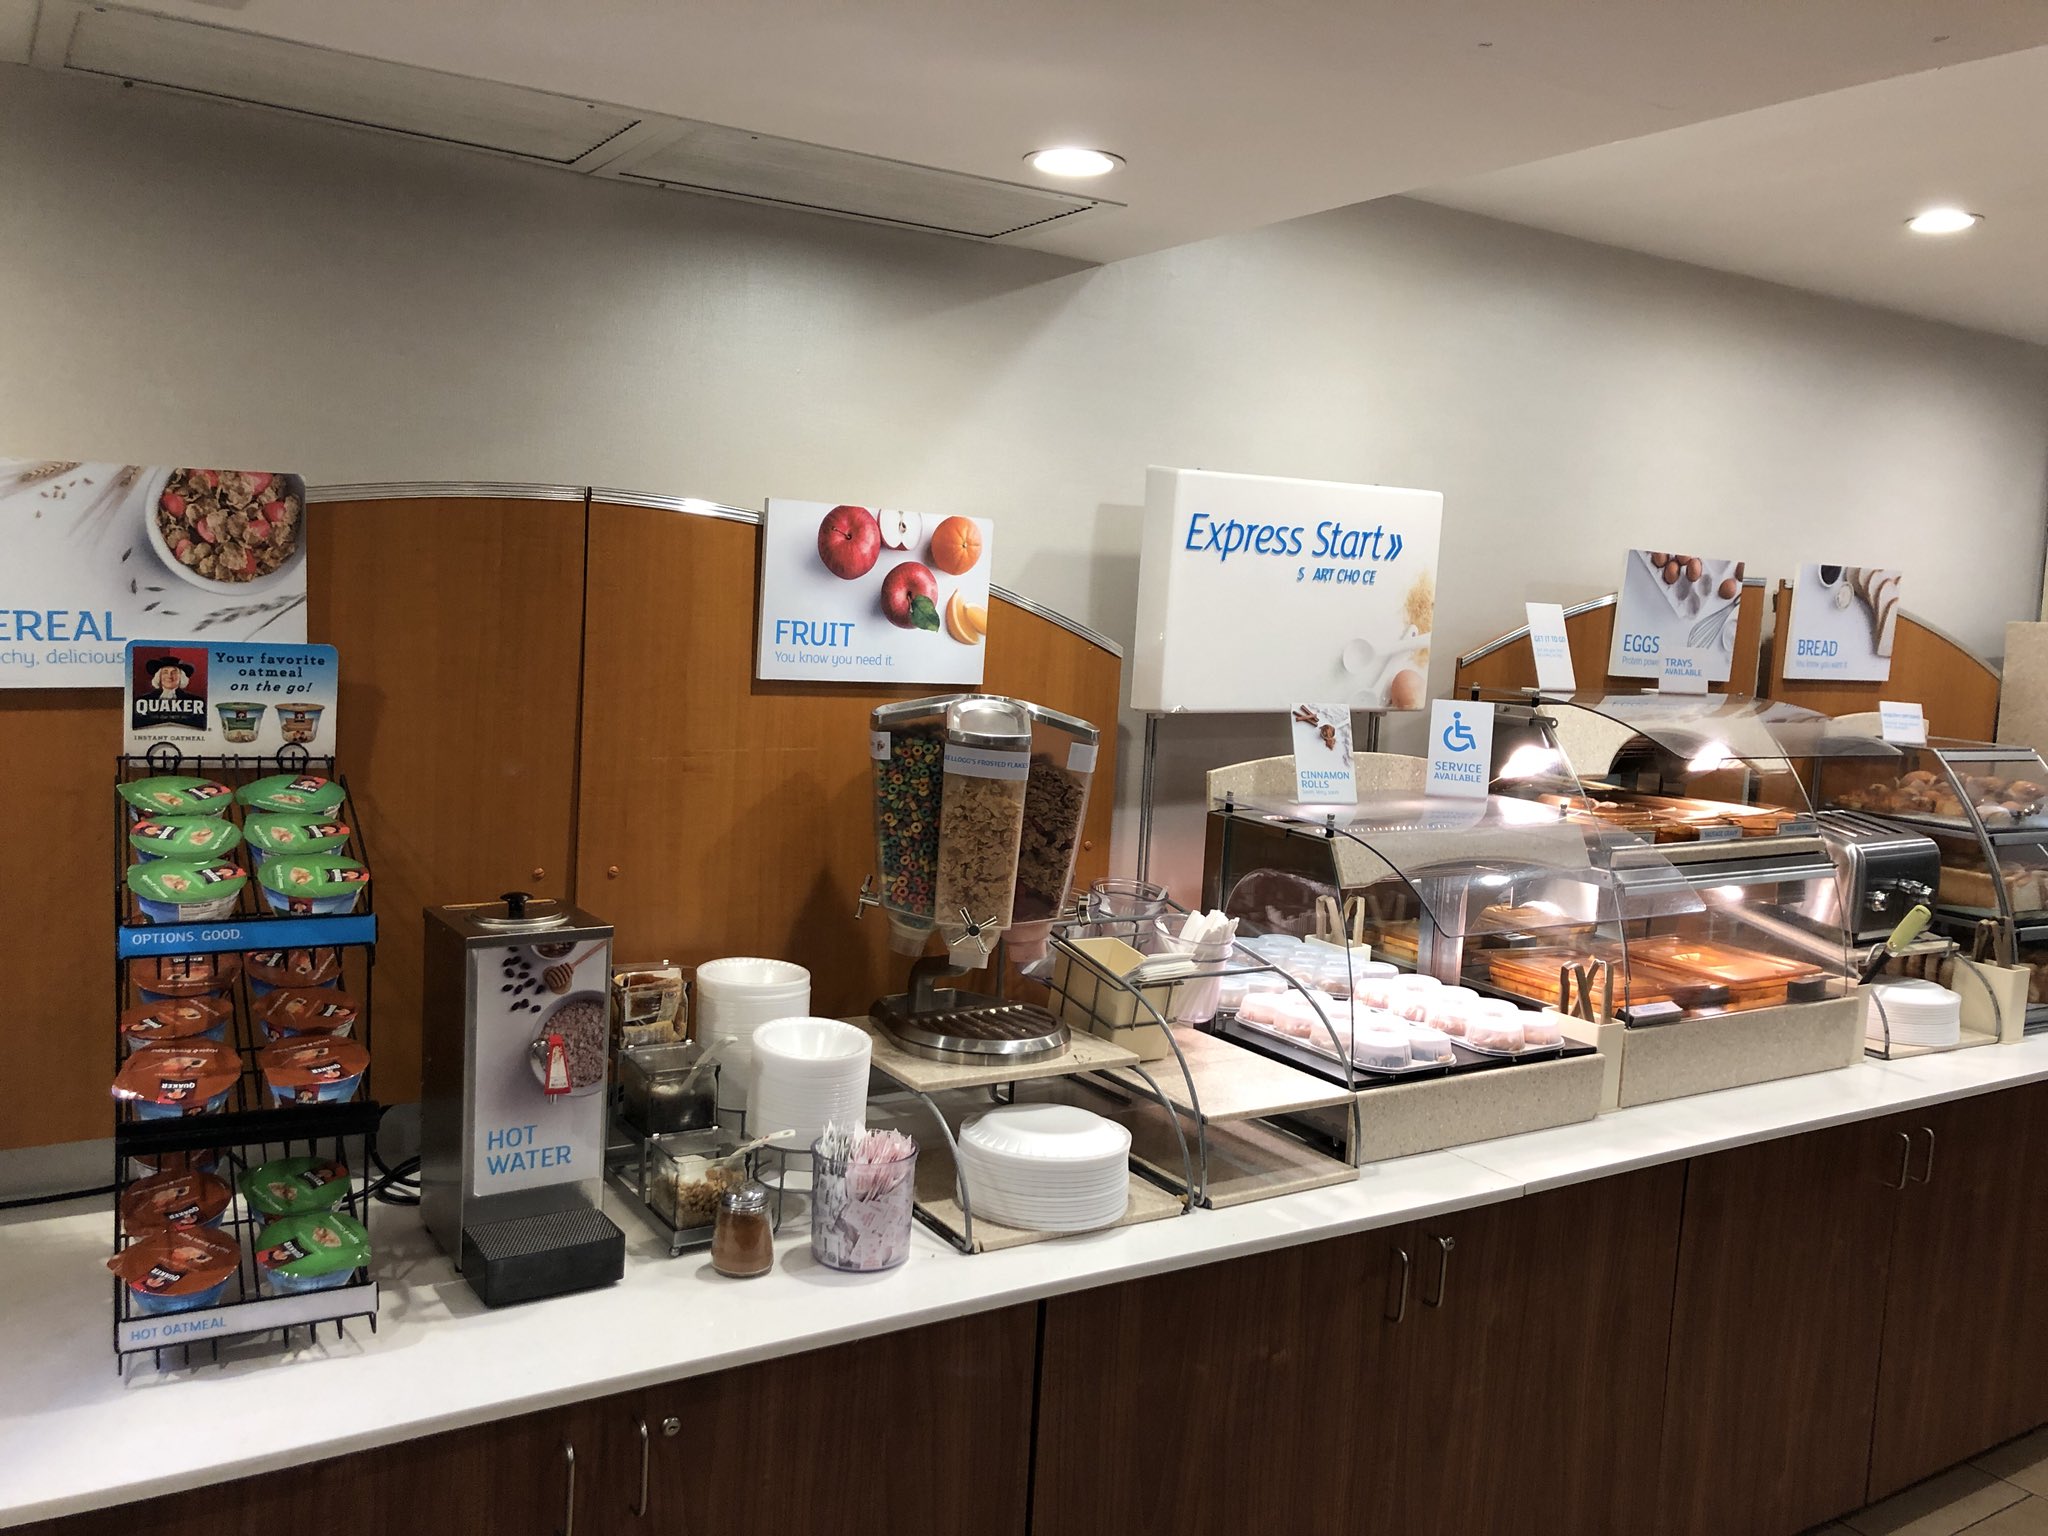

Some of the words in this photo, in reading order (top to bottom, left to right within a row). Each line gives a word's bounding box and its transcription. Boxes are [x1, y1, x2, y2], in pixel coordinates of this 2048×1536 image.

[1185, 513, 1304, 562] Express
[1311, 521, 1385, 560] Start
[775, 619, 855, 647] FRUIT
[1623, 634, 1660, 654] EGGS
[1797, 639, 1838, 656] BREAD
[46, 649, 125, 664] delicious
[216, 653, 253, 664] Your
[260, 653, 326, 666] favorite
[775, 651, 795, 663] You
[799, 651, 829, 664] know
[832, 655, 852, 667] you
[856, 654, 882, 666] need
[1665, 658, 1692, 668] TRAYS
[239, 667, 303, 678] oatmeal
[1664, 668, 1702, 676] AVAILABLE
[230, 683, 249, 692] on
[256, 682, 280, 692] the
[286, 683, 312, 694] go!
[136, 699, 205, 715] QUAKER
[1435, 761, 1482, 773] SERVICE
[1300, 771, 1350, 780] CINNAMON
[1434, 772, 1481, 783] AVAILABLE
[1301, 780, 1329, 788] ROLLS
[132, 932, 197, 945] OPTIONS.
[201, 929, 243, 941] GOOD.
[488, 1124, 538, 1151] HOT
[486, 1145, 572, 1176] WATER
[130, 1327, 157, 1340] HOT
[162, 1316, 226, 1336] OATMEAL
